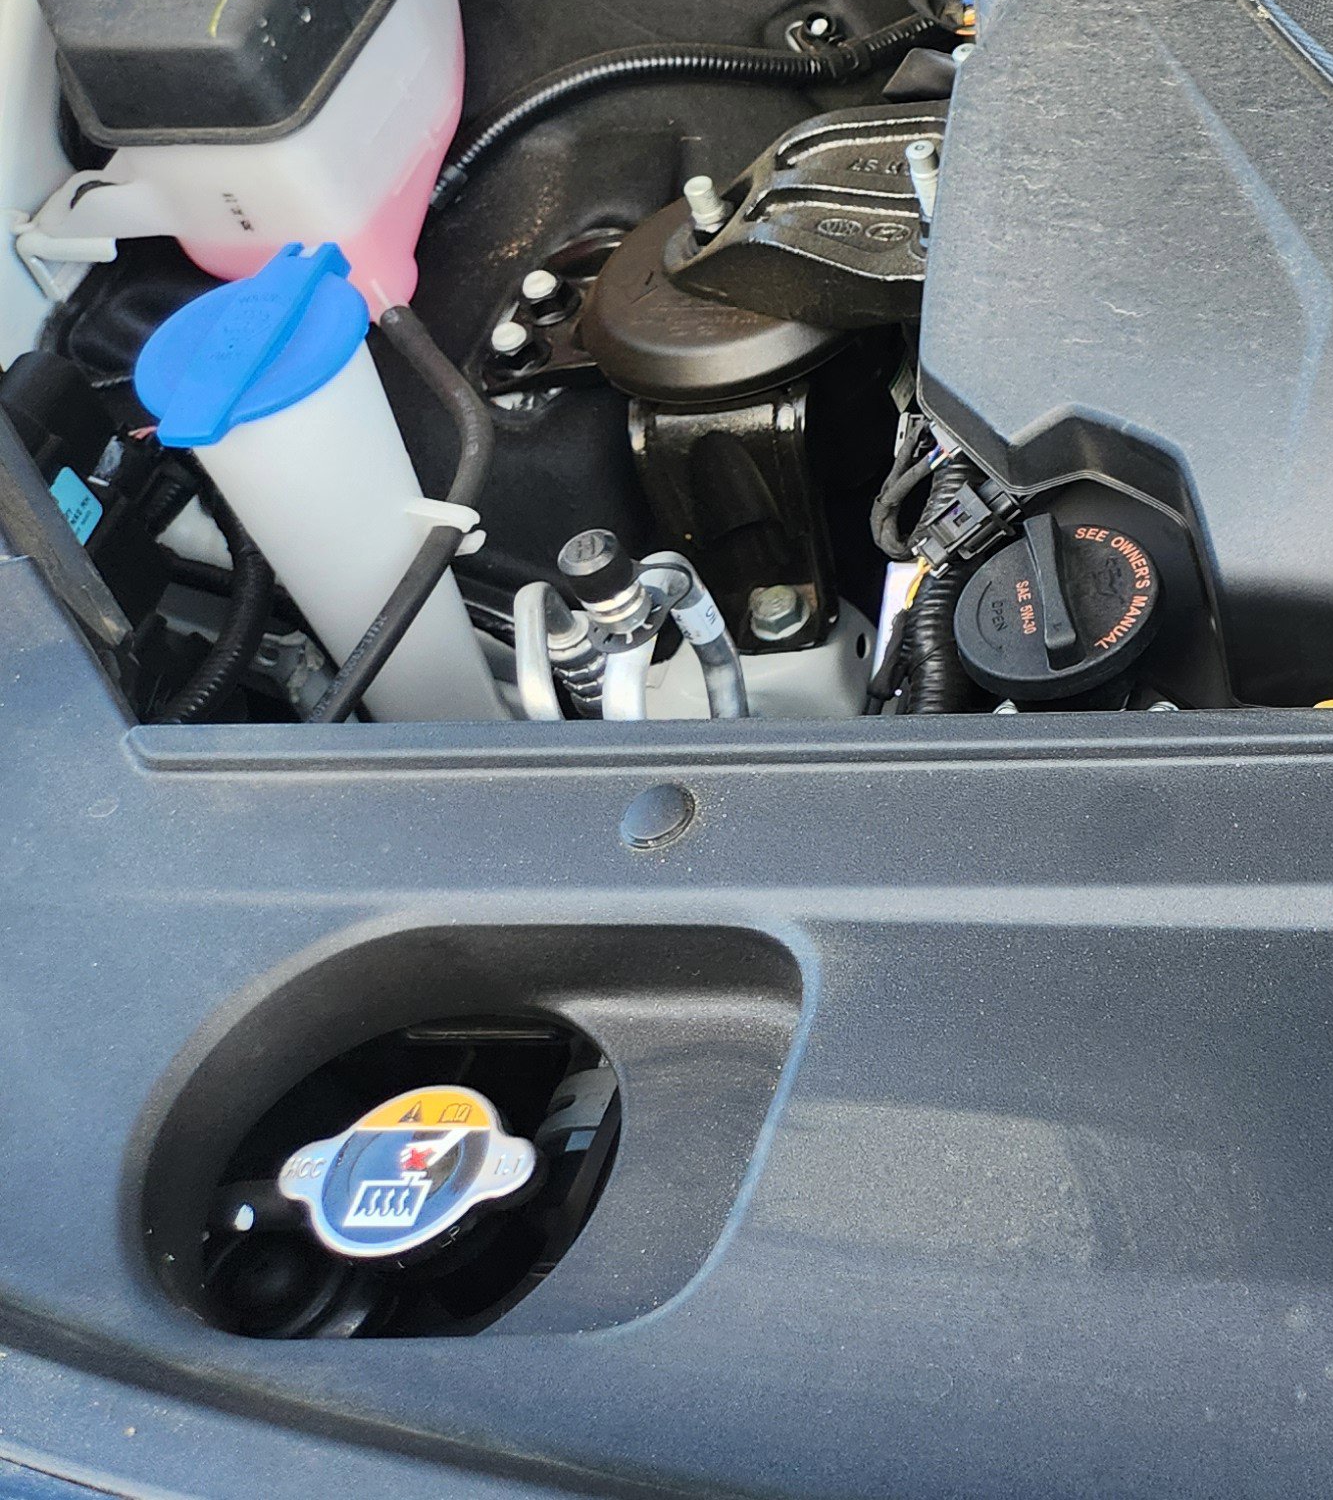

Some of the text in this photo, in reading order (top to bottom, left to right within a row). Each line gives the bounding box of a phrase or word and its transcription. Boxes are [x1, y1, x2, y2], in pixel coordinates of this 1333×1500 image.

[1016, 580, 1037, 635] SAE 5W-30
[1075, 527, 1150, 649] SEE OWNER'S MANUAL
